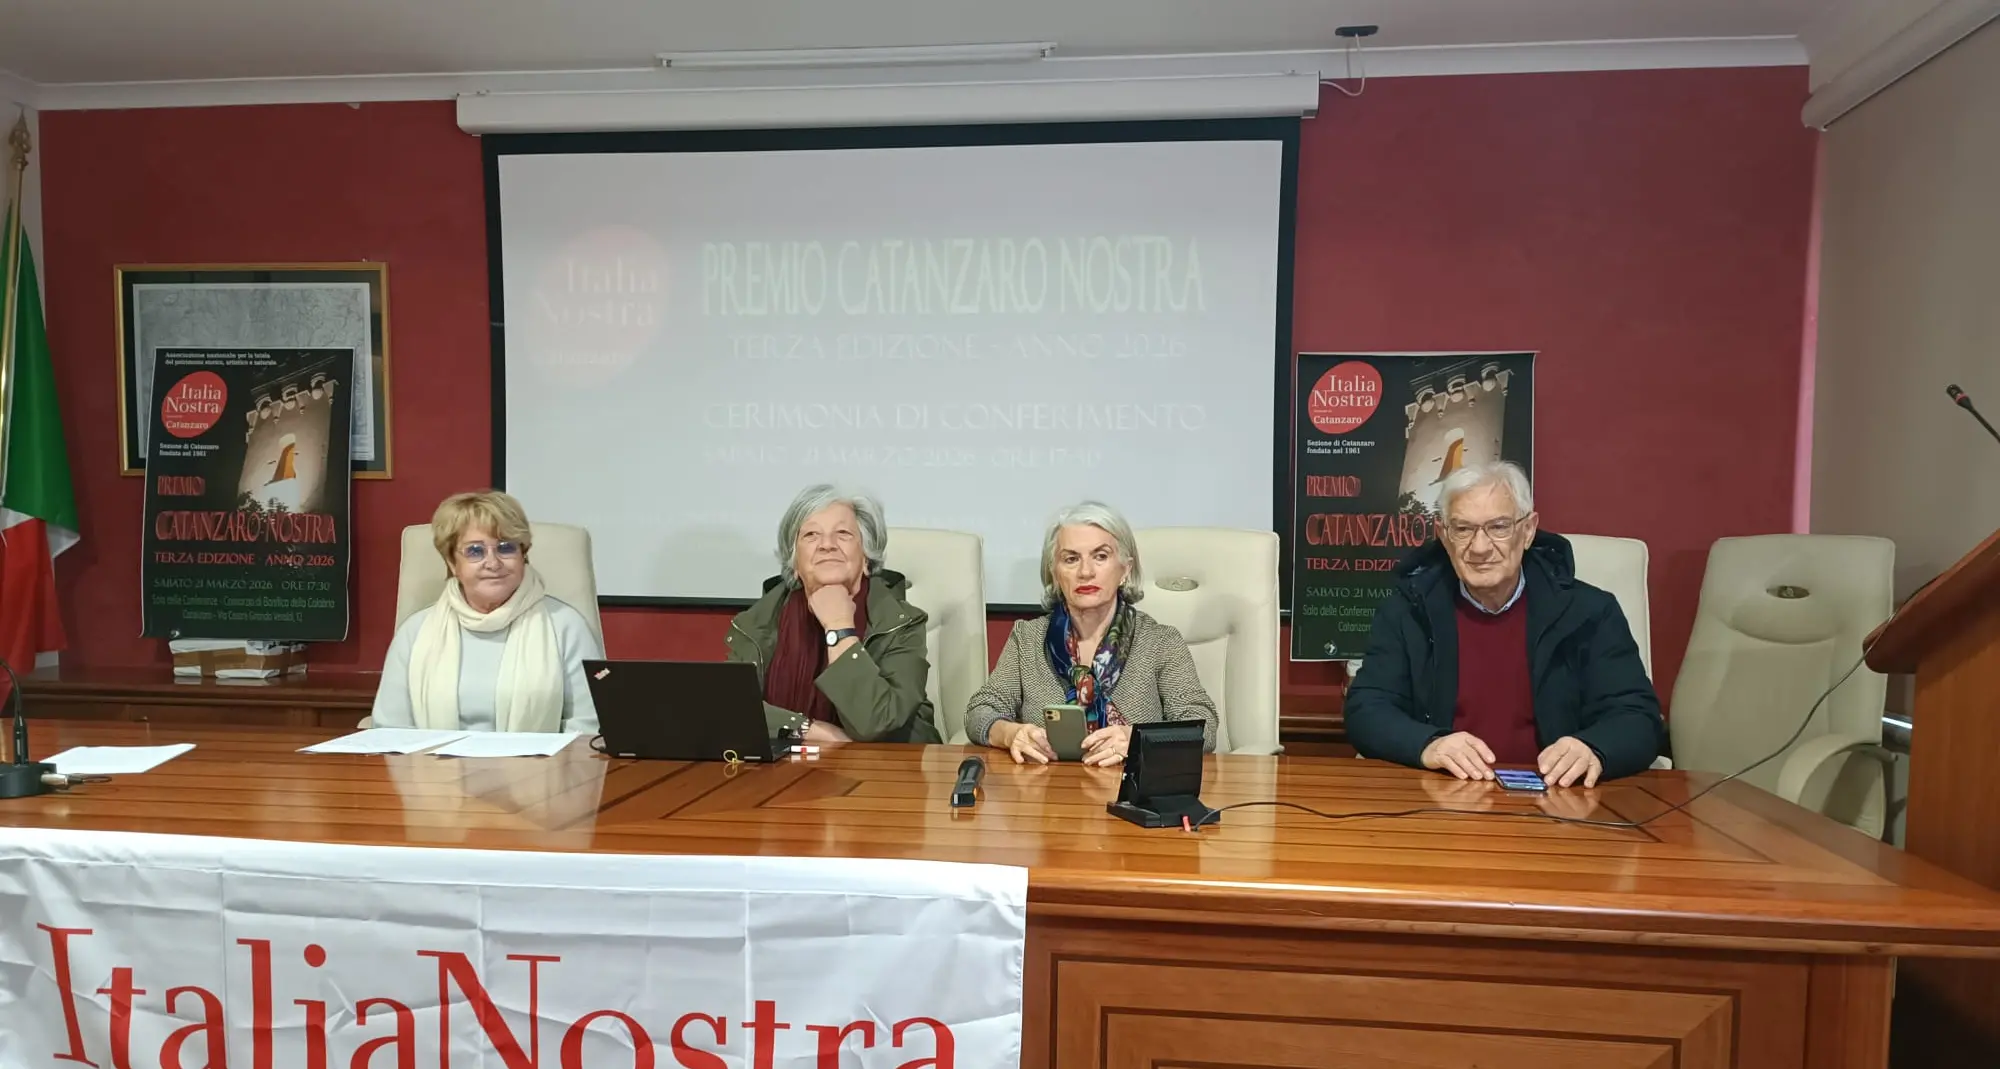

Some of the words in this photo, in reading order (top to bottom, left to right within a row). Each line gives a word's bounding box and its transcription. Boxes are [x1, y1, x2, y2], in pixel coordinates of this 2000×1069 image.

[702, 240, 828, 316] PREMIO
[837, 238, 1048, 317] CATANZARO
[1059, 236, 1207, 315] NOSTRA
[728, 334, 826, 360] TERZA
[836, 334, 981, 361] EDIZIONE
[1009, 333, 1104, 359] ANNO
[1115, 333, 1188, 359] 2026
[180, 383, 222, 400] Italia
[1329, 373, 1377, 393] Italia
[165, 396, 220, 414] Nostra
[1312, 389, 1375, 408] Nostra
[165, 419, 209, 430] Catanzaro
[702, 402, 884, 430] CERIMONIA
[894, 402, 929, 430] DI
[938, 402, 1208, 432] CONFERIMENTO
[1313, 415, 1362, 425] Catanzaro
[1307, 439, 1332, 447] Sezione
[1333, 439, 1340, 447] di
[1341, 439, 1375, 447] Catanzaro
[157, 476, 205, 496] PREMIO
[1306, 475, 1360, 497] PREMIO
[155, 510, 260, 543] CATANZARO
[265, 512, 336, 544] NOSTRA
[1305, 513, 1427, 547] CATANZARO
[155, 551, 194, 565] TERZA
[197, 552, 256, 565] EDIZIONE
[265, 554, 304, 567] ANNO
[306, 555, 335, 567] 2026
[1304, 557, 1350, 571] TERZA
[1354, 557, 1400, 572] EDIZI
[153, 578, 193, 589] SABATO
[206, 579, 248, 590] MARZO
[249, 579, 273, 590] 2026
[281, 581, 304, 591] ORE
[1305, 586, 1351, 598] SABATO
[1351, 587, 1364, 599] 21
[1366, 588, 1393, 599] MAR
